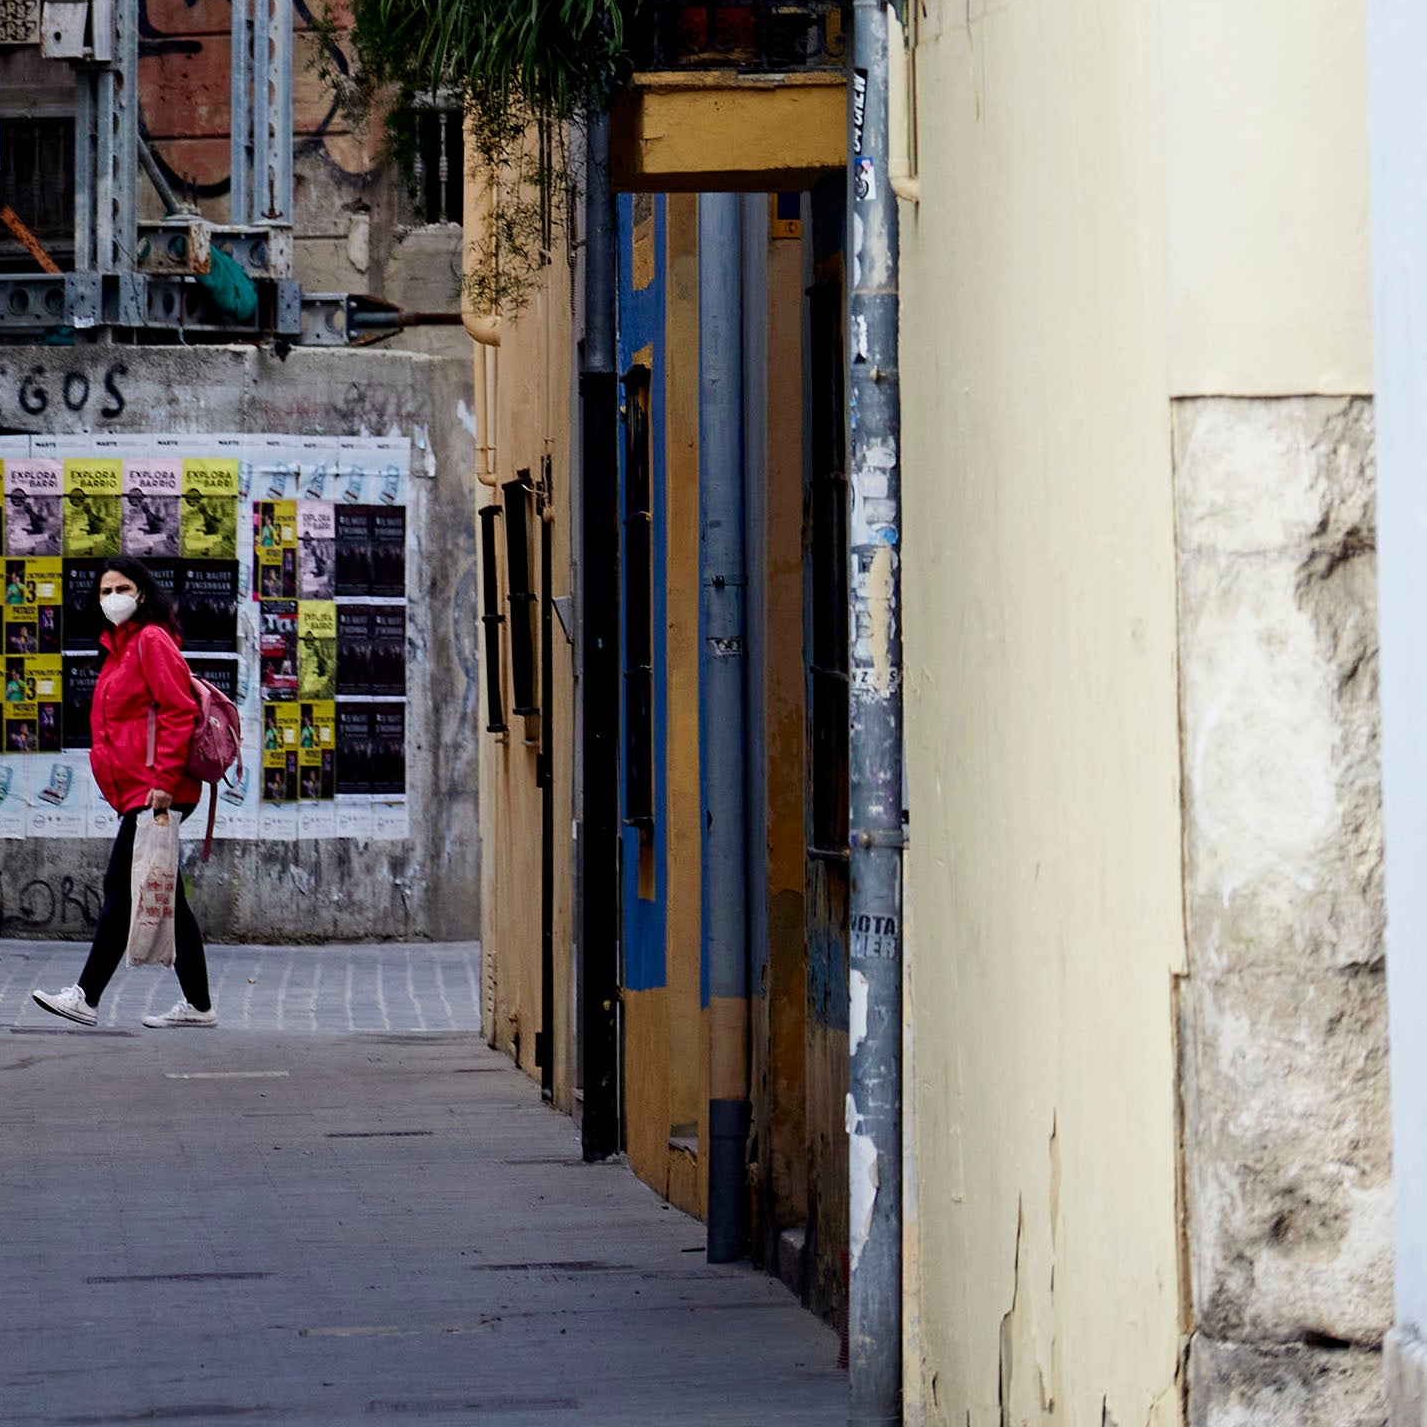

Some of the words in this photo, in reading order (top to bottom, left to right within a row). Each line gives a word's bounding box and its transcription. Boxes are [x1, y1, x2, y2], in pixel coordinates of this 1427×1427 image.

[11, 470, 57, 480] EXPLORA
[70, 470, 117, 480] EXPLORA
[129, 470, 176, 480] EXPLORA
[186, 470, 232, 480] EXPLORA
[29, 479, 58, 488] BARRI
[79, 479, 117, 488] BARRIO
[139, 479, 176, 488] BARRIO
[204, 479, 233, 488] BARRI
[26, 580, 37, 604] 3
[26, 676, 37, 701] 3
